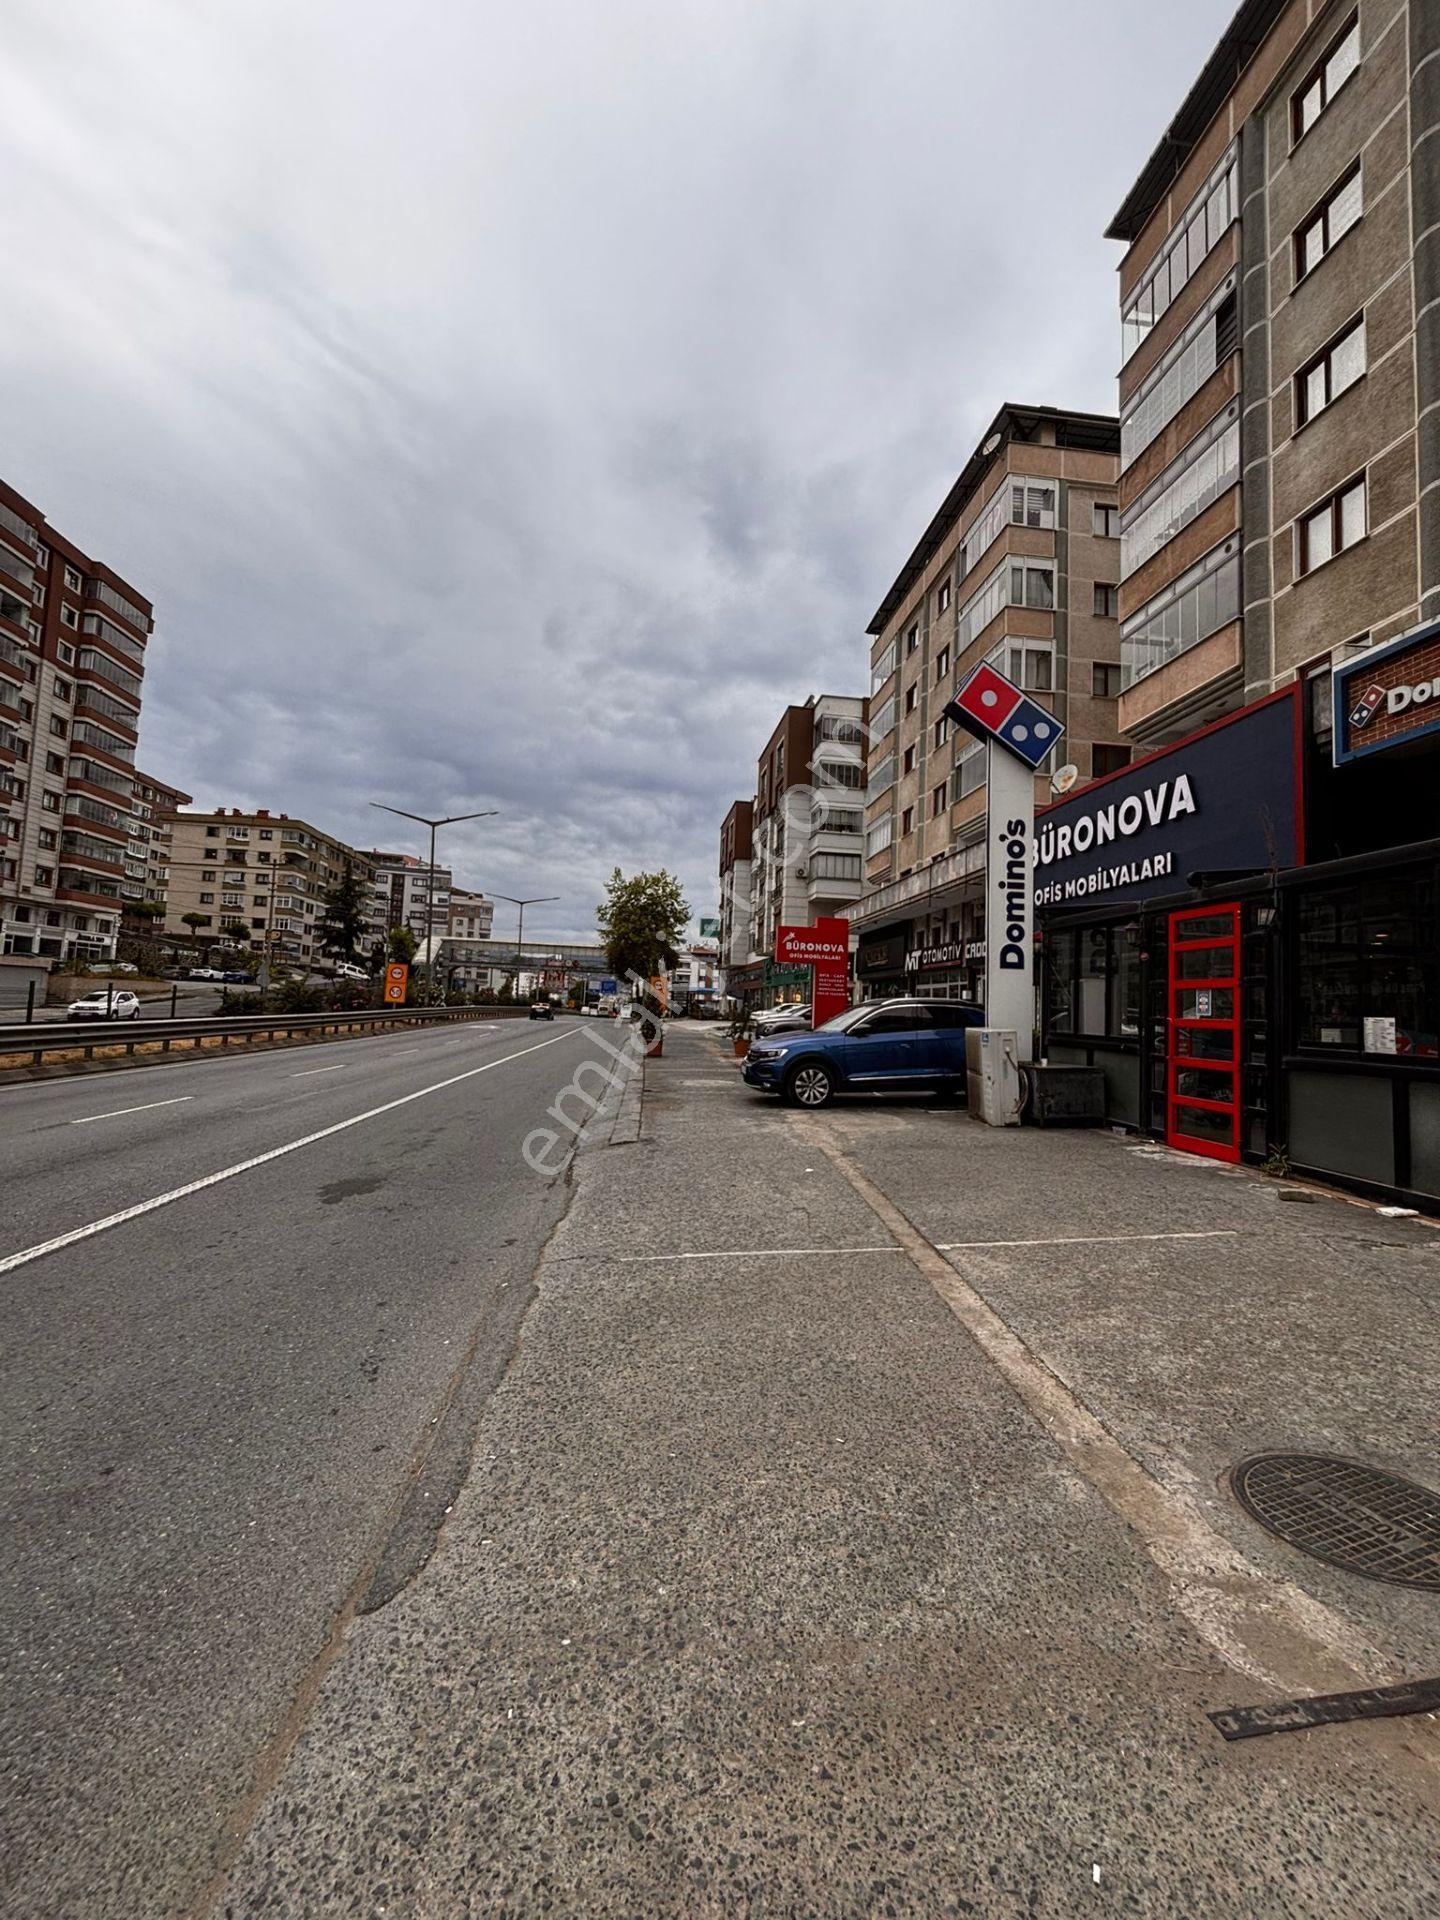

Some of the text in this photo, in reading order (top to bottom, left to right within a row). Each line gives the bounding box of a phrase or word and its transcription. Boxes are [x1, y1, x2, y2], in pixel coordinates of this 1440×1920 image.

[1387, 677, 1440, 714] Do
[999, 819, 1026, 969] Domino's
[1034, 852, 1172, 906] OFİS MOBİLYALARI
[786, 940, 844, 953] BÜRONOVA
[922, 941, 961, 964] OTOMOTİV
